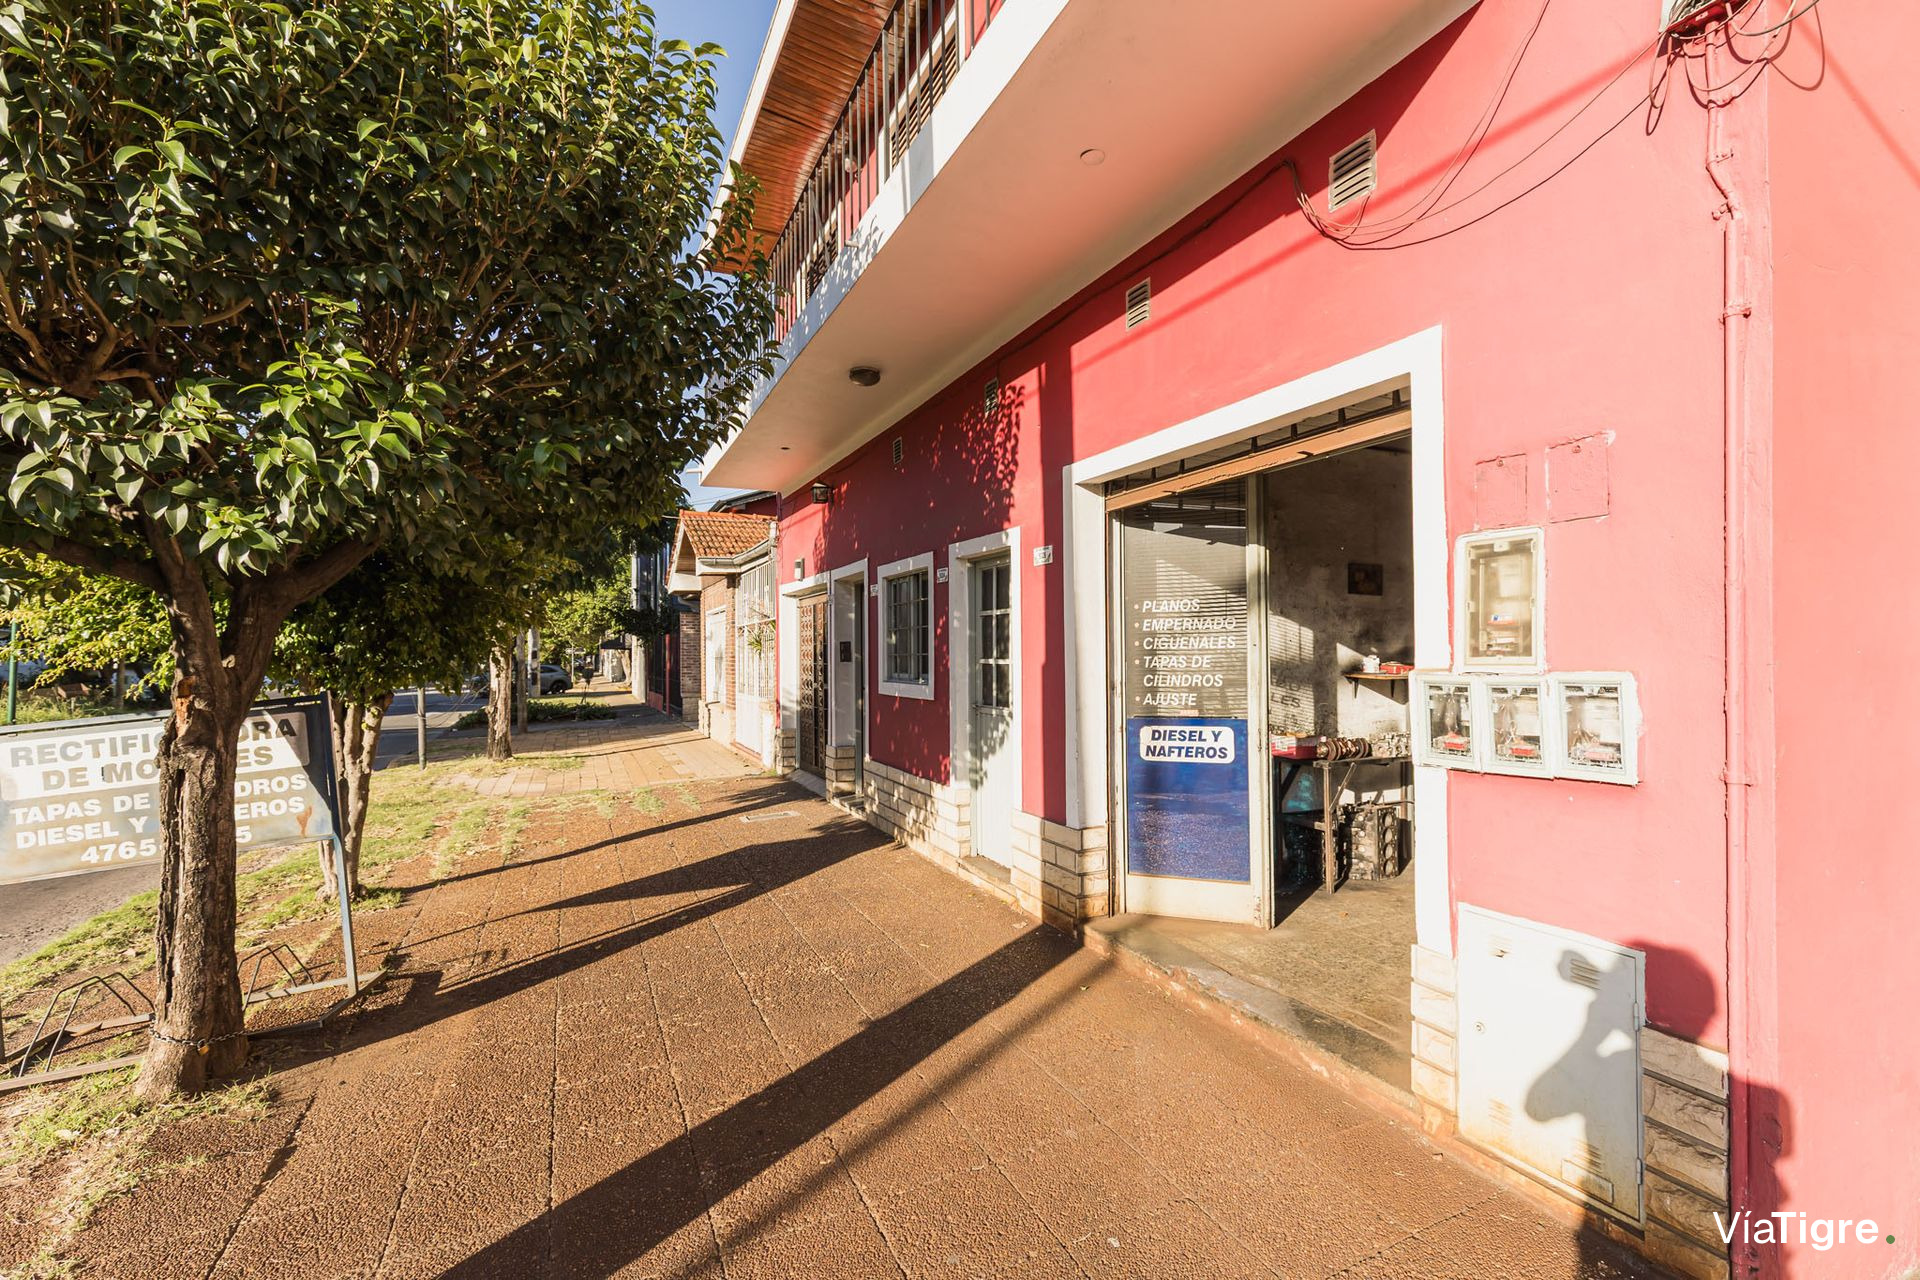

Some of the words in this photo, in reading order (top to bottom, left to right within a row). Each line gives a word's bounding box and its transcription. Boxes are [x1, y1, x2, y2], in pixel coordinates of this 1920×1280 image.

[1142, 598, 1200, 613] PLANOS
[1142, 617, 1236, 631] EMPERNADO
[1143, 655, 1187, 668] TAPAS
[1191, 655, 1212, 668] DE
[1143, 674, 1224, 687] CILINDROS
[1143, 693, 1198, 706] AJUSTE
[1151, 729, 1207, 742] DIESEL
[1211, 730, 1222, 742] Y
[1145, 745, 1228, 759] NAFTEROS
[42, 767, 89, 791] DE
[9, 798, 103, 825] TAPAS
[113, 793, 150, 813] DE
[16, 821, 119, 849] DIESEL
[128, 816, 148, 834] Y
